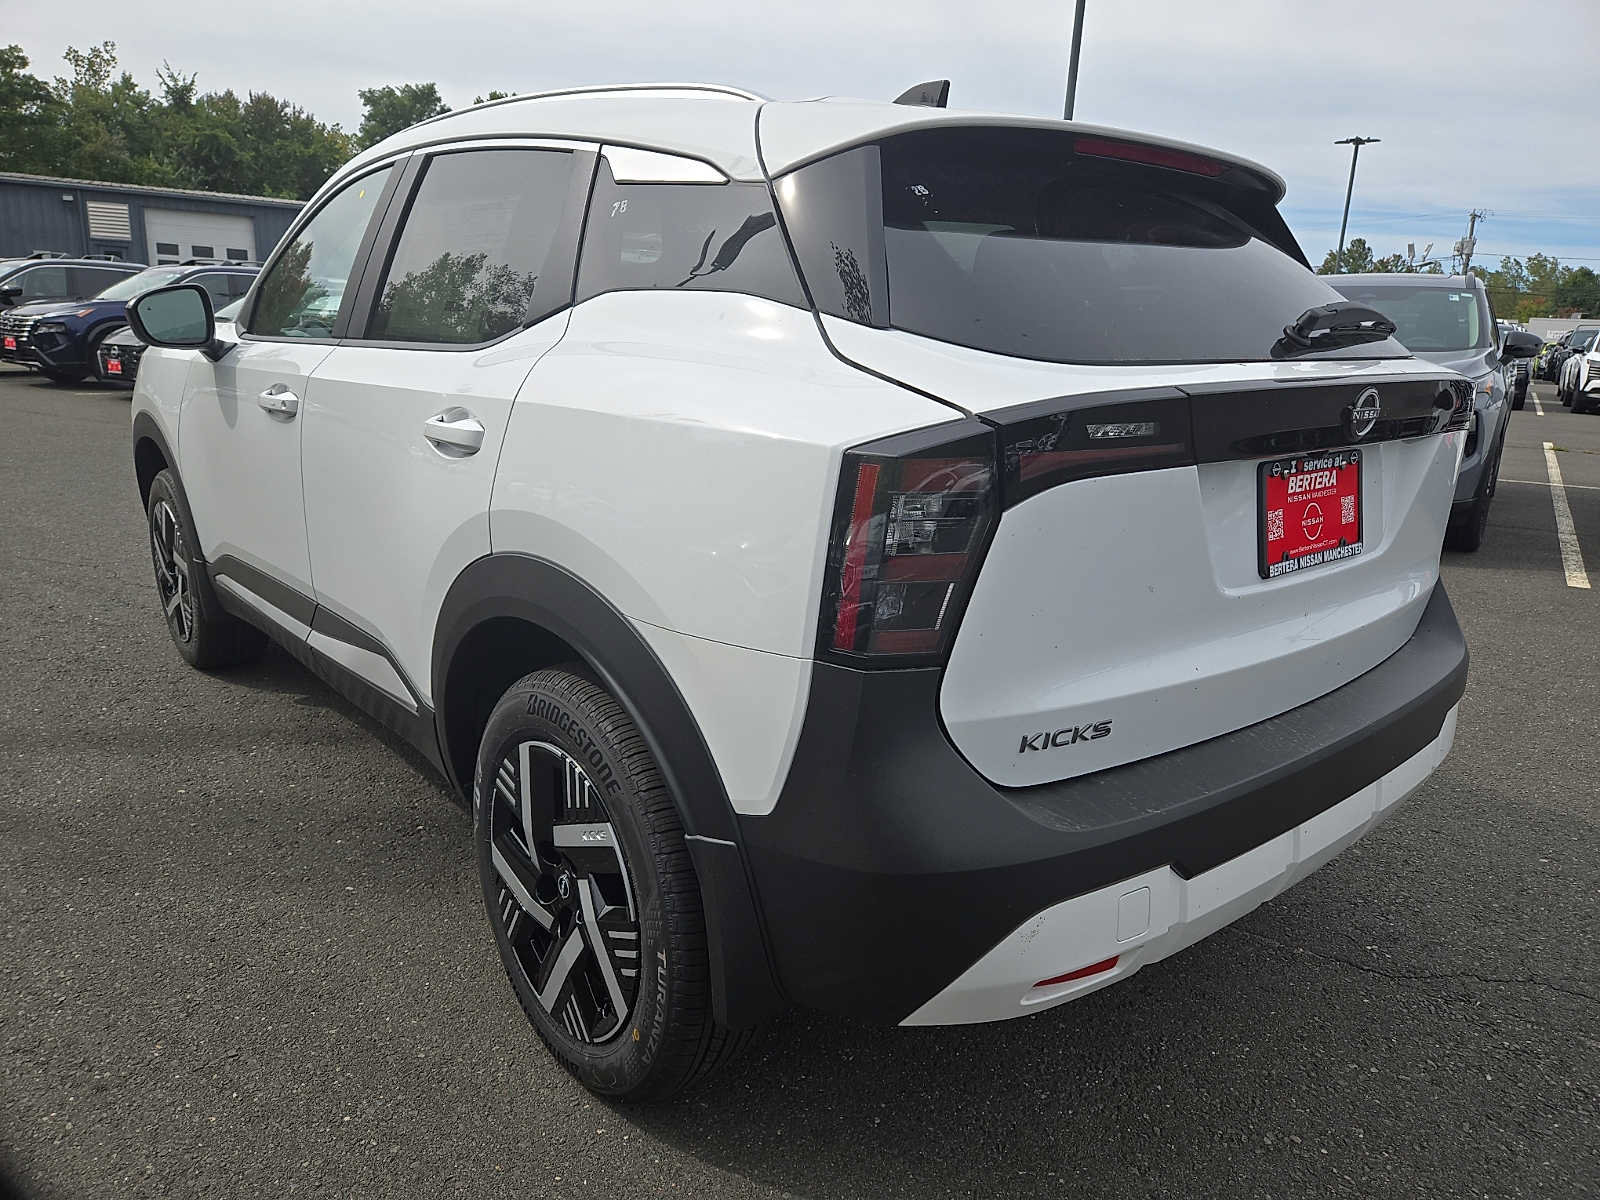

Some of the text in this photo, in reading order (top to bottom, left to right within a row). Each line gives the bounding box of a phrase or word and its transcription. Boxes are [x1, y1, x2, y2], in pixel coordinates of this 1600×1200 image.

[1303, 457, 1333, 471] service
[1287, 470, 1337, 494] BERTERA
[1287, 493, 1311, 503] NISSAN
[1301, 516, 1324, 527] NISSAN
[1269, 542, 1363, 577] BERTERA NISSAN MANCHESTER
[527, 694, 621, 797] BRIDGESTONE
[1019, 719, 1113, 754] KICKS
[641, 949, 668, 1066] TURANZA
